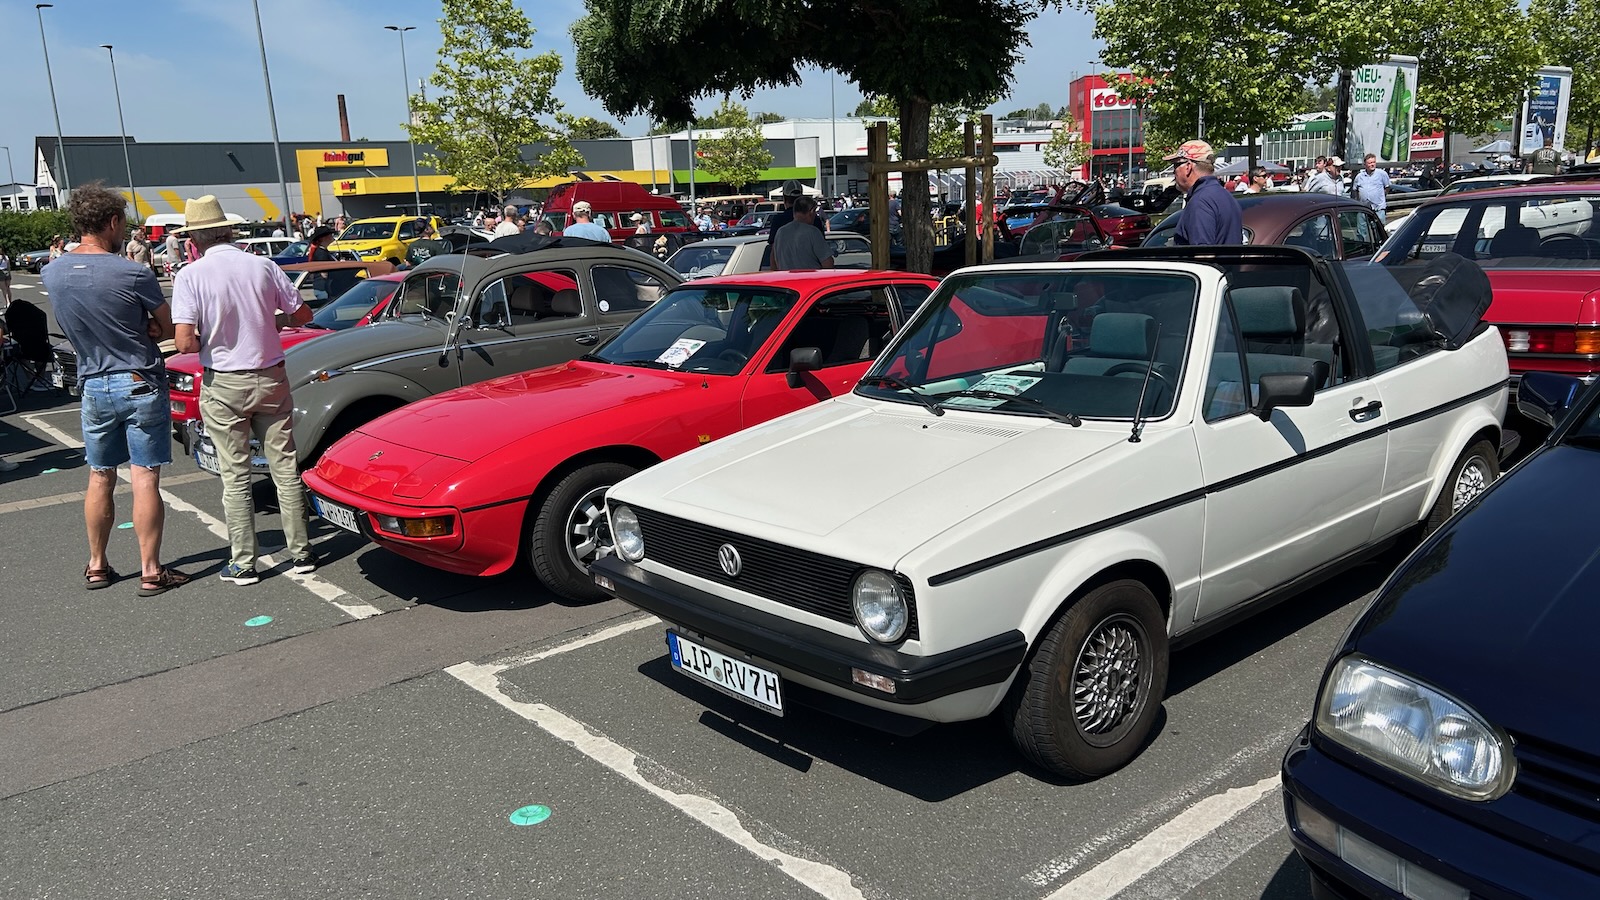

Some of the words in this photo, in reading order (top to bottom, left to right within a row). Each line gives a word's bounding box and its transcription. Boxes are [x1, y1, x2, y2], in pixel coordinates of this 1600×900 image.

[1356, 68, 1382, 83] NEU-
[1355, 87, 1386, 103] BIERIG?
[324, 151, 364, 164] trinkgut
[678, 640, 712, 675] LIP
